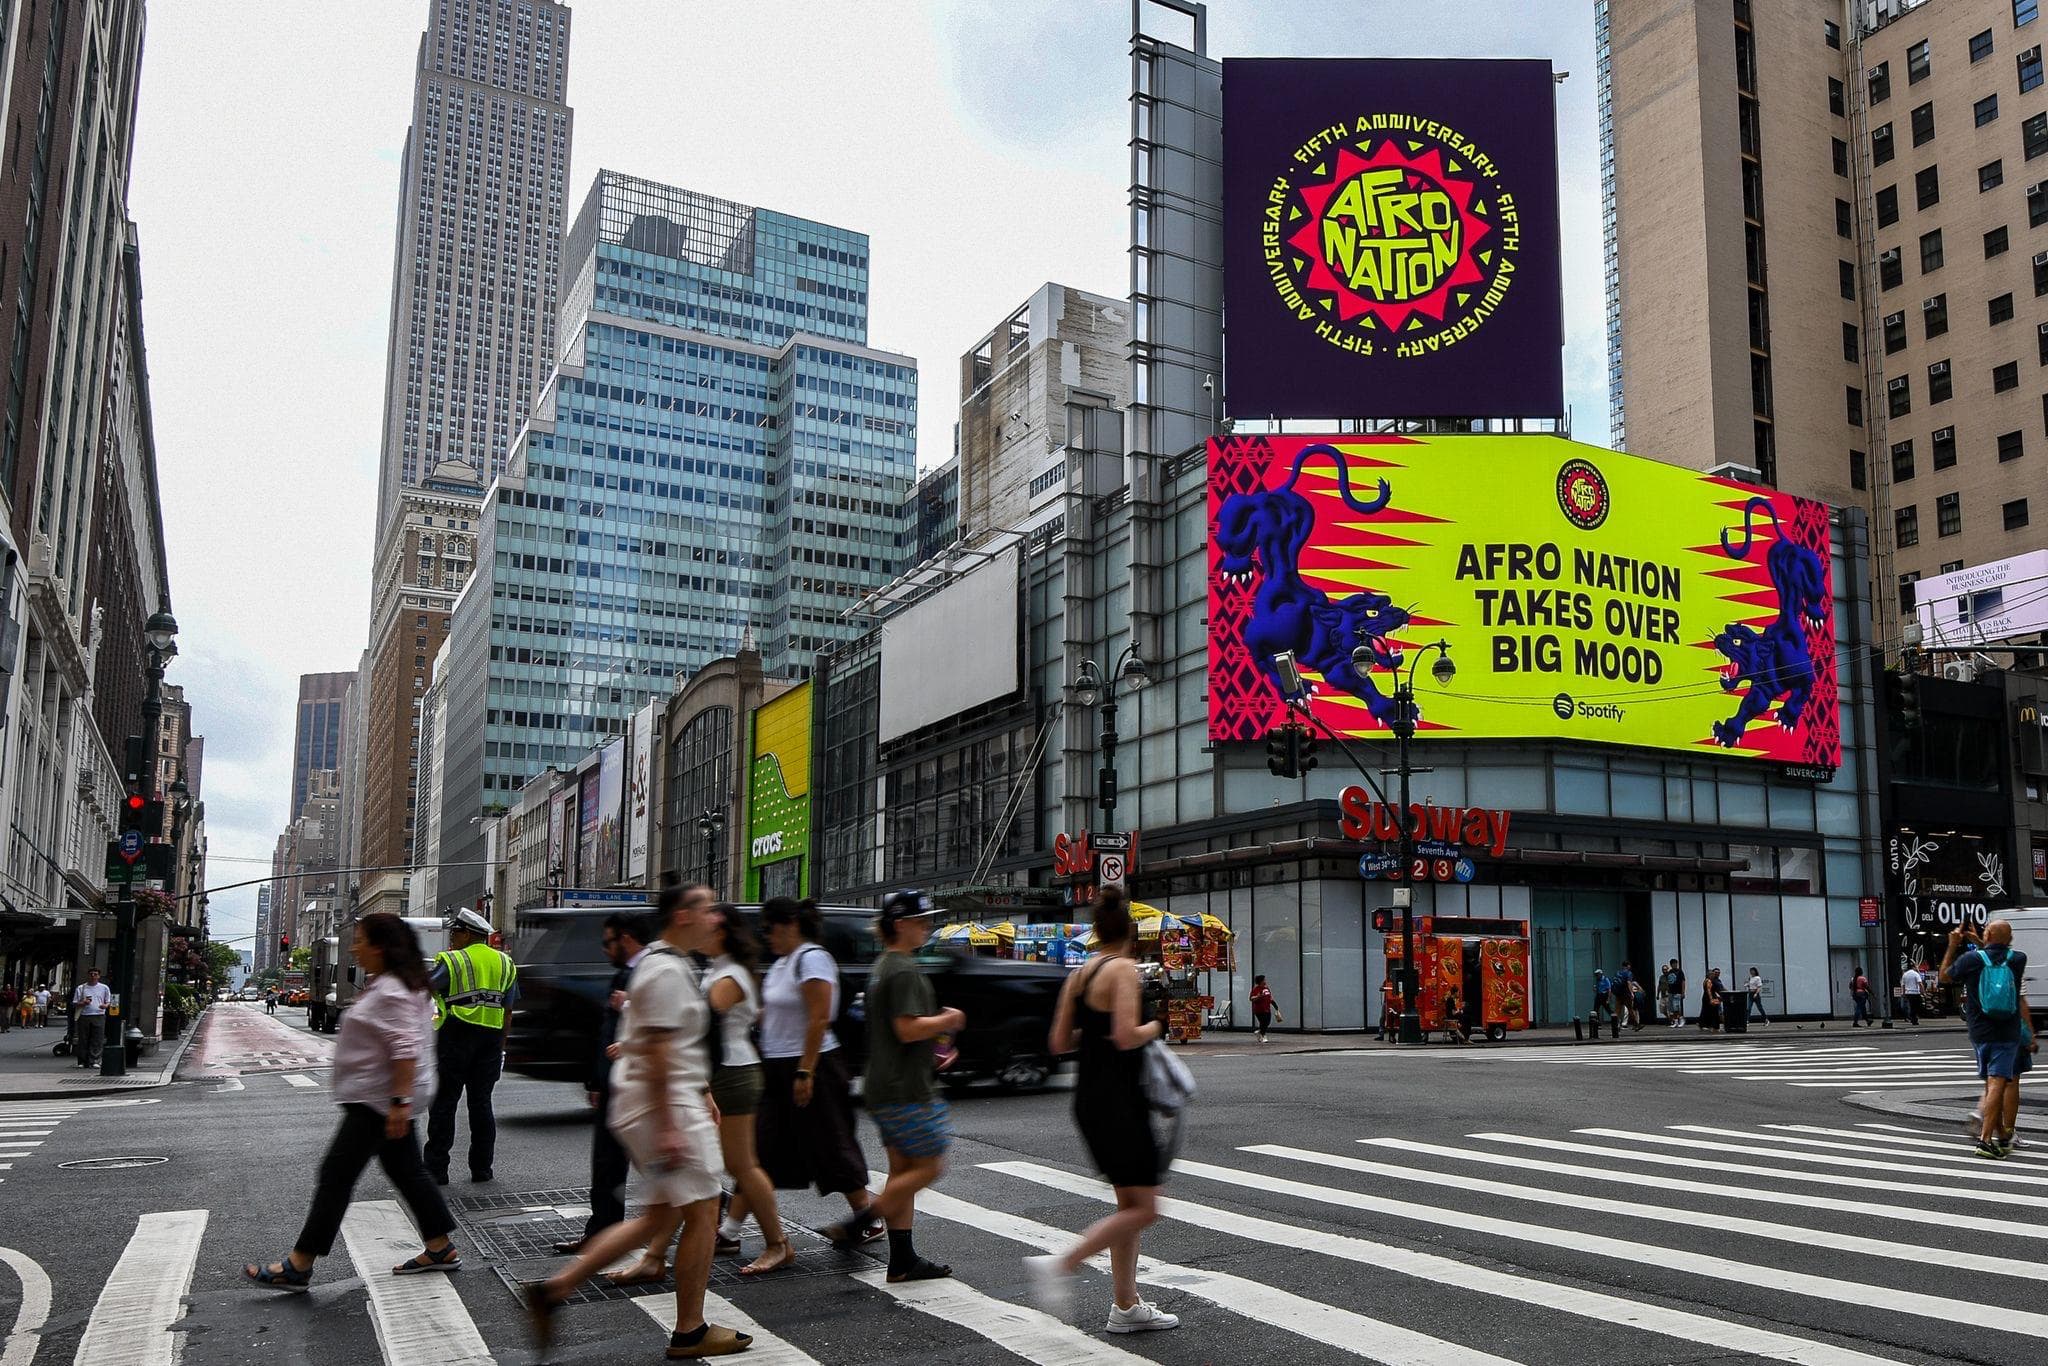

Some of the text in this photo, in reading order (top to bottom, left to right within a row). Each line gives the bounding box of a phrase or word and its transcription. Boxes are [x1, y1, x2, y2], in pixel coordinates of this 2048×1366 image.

[1294, 113, 1498, 179] FIFTH ANNIVERSARY
[1327, 169, 1452, 237] AFRO
[1263, 176, 1374, 356] FIFTH ANNIVERSARY
[1322, 218, 1459, 301] NATION
[1396, 193, 1520, 359] FIFTH ANNIVERSARY
[1571, 478, 1595, 497] AFRO
[1455, 542, 1681, 603] AFRO NATION
[1945, 563, 2011, 586] INTRODUCING THE
[1951, 572, 2006, 591] BUSINESS CARD
[1474, 588, 1680, 645] TAKES OVER
[1992, 616, 2012, 627] BACK
[1491, 634, 1663, 685] BIG MOOD
[1578, 701, 1624, 723] Spotify
[752, 830, 784, 858] crocs
[1417, 845, 1445, 856] Seventh
[1368, 862, 1381, 871] West
[1391, 859, 1398, 869] St
[1413, 859, 1424, 877] 2
[1438, 860, 1449, 877] 3
